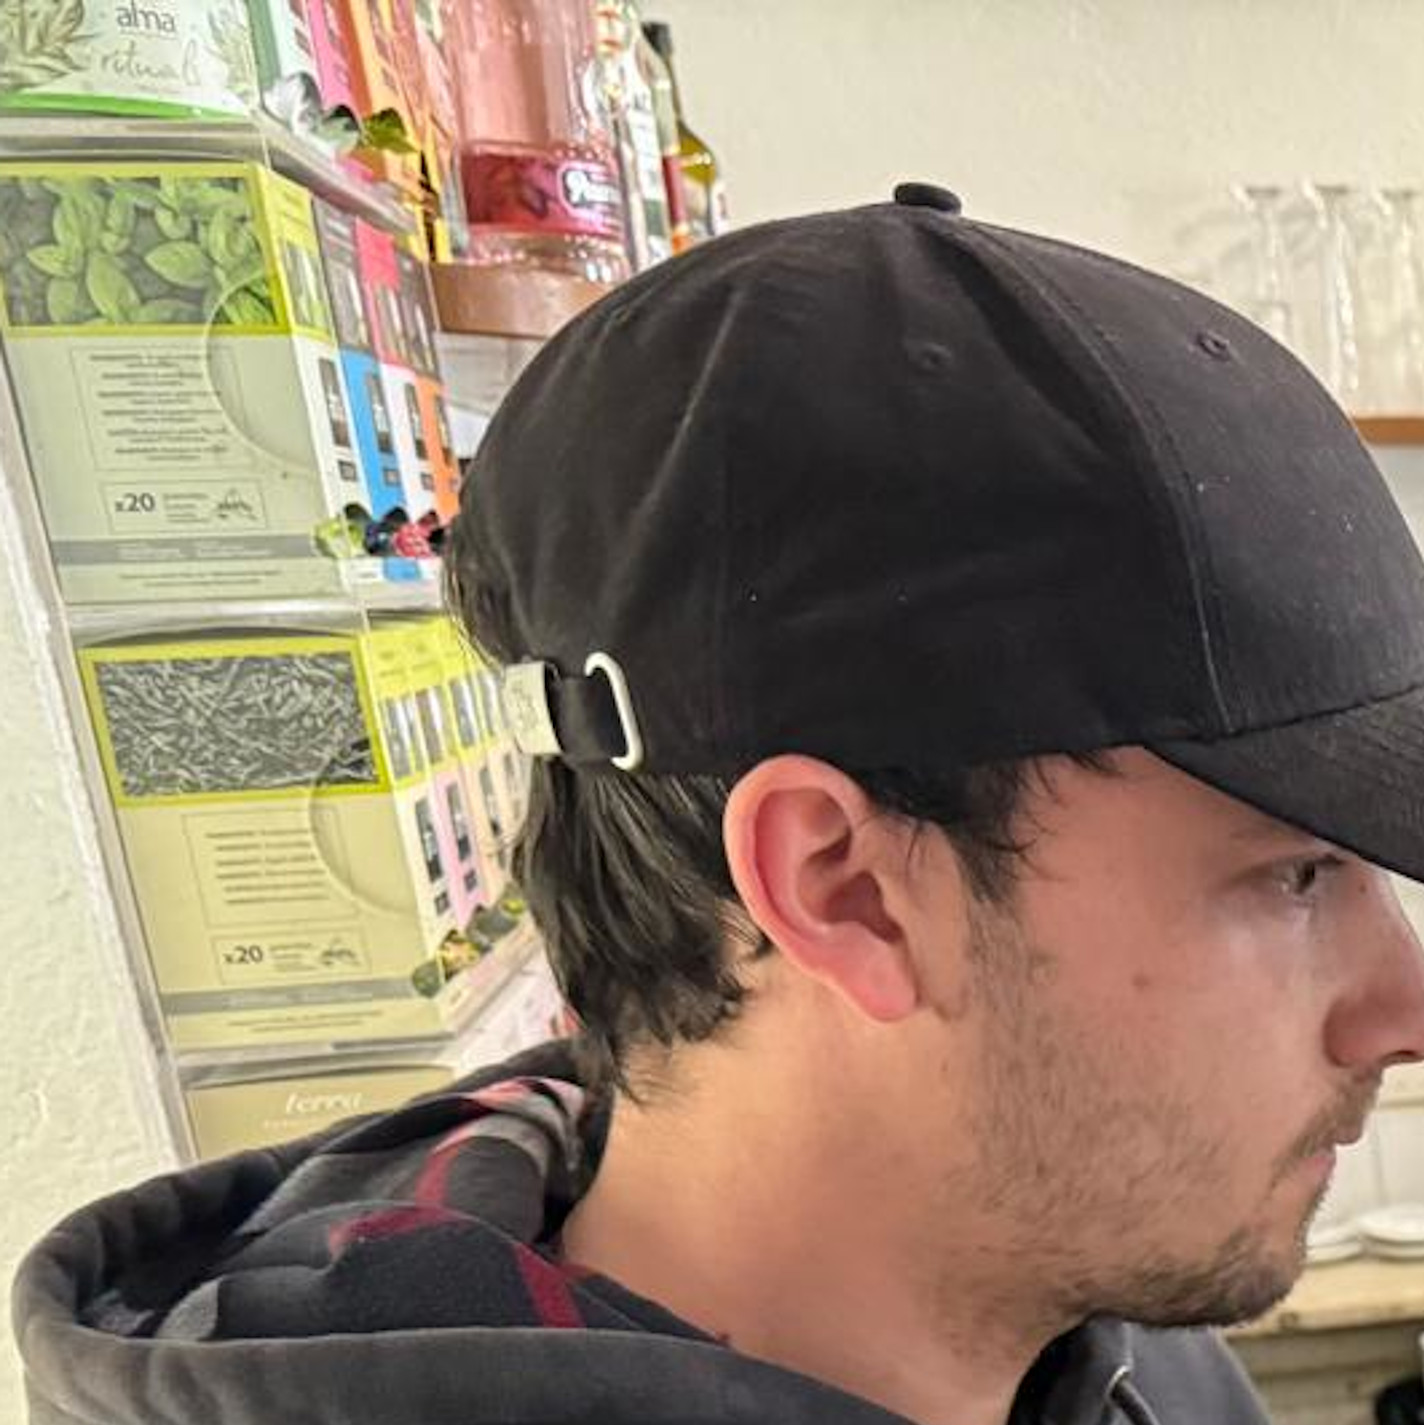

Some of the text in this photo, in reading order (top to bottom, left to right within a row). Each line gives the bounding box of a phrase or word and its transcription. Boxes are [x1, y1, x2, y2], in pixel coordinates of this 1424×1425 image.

[115, 0, 176, 33] alma
[115, 492, 156, 513] x20
[222, 944, 264, 965] x20
